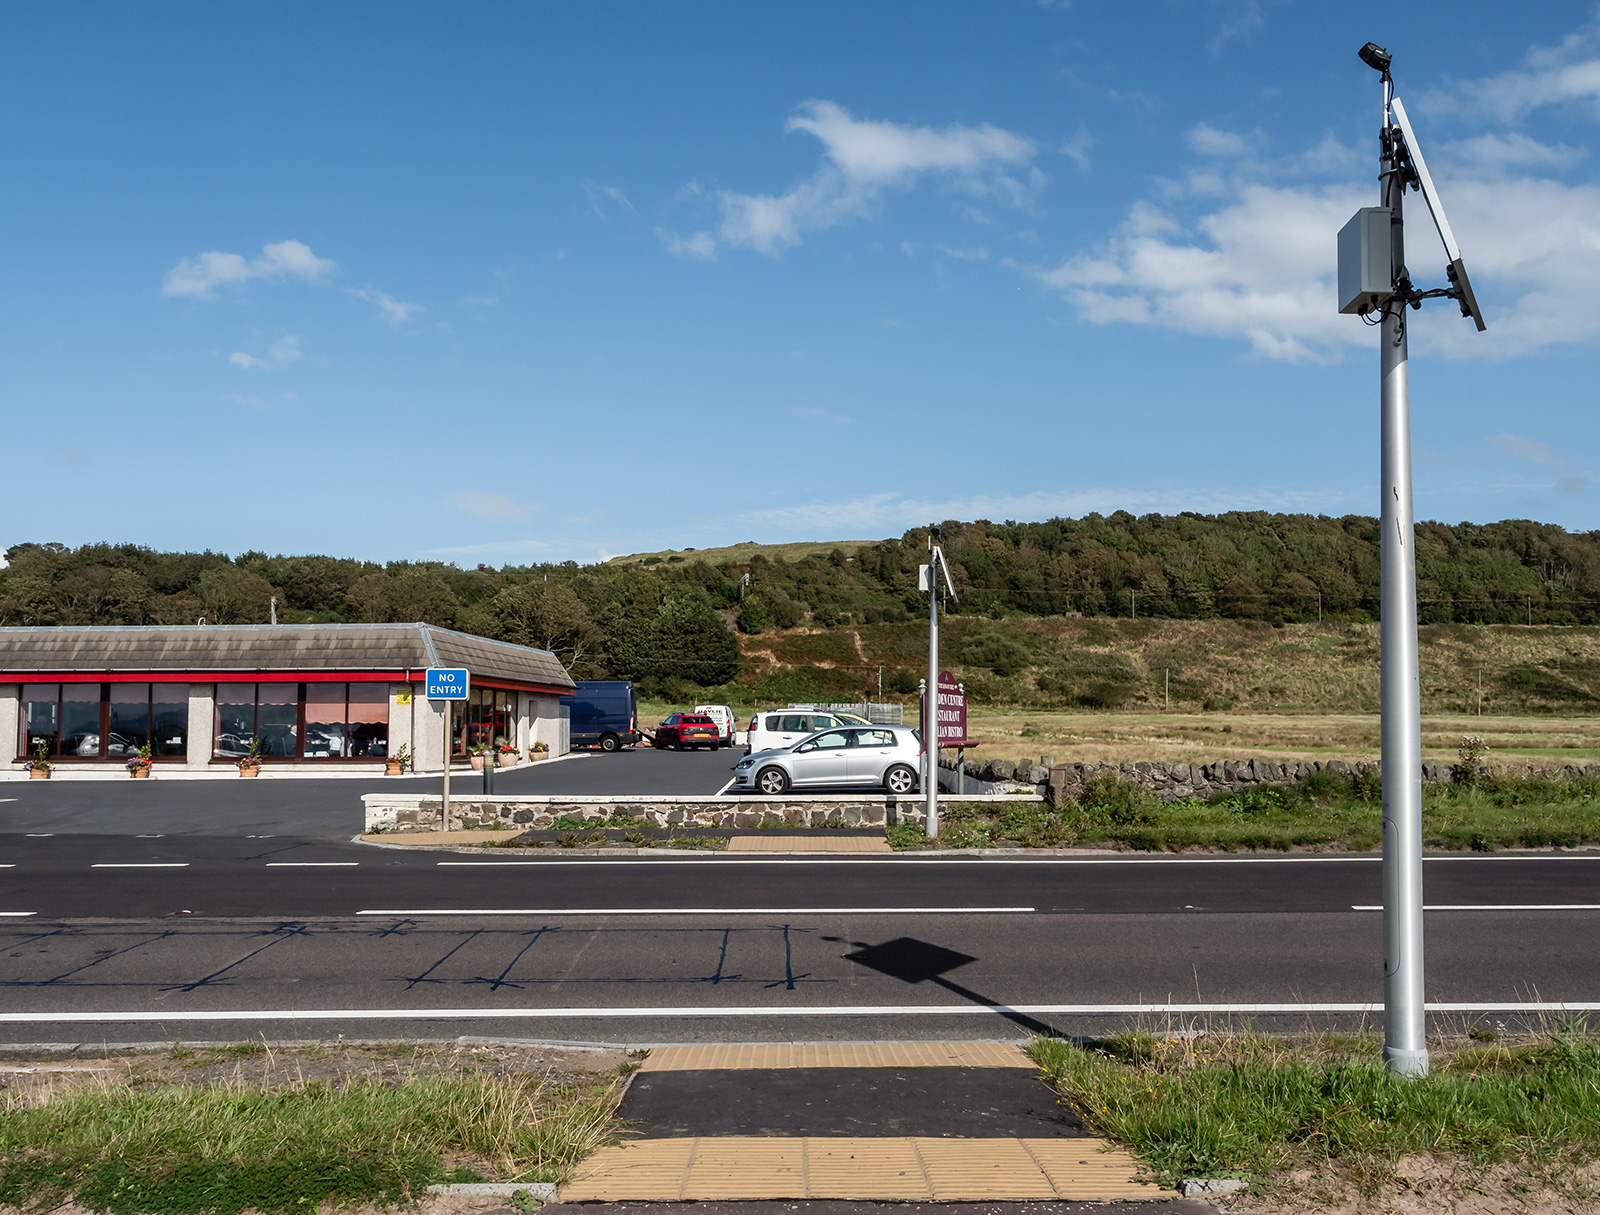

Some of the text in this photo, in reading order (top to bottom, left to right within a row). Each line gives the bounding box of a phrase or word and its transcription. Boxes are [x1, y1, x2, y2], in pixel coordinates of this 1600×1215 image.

[439, 673, 455, 682] NO
[430, 685, 463, 694] ENTRY
[947, 694, 964, 706] CENTRE
[938, 710, 960, 721] STAURANT
[937, 725, 964, 737] LIAN BISTRO
